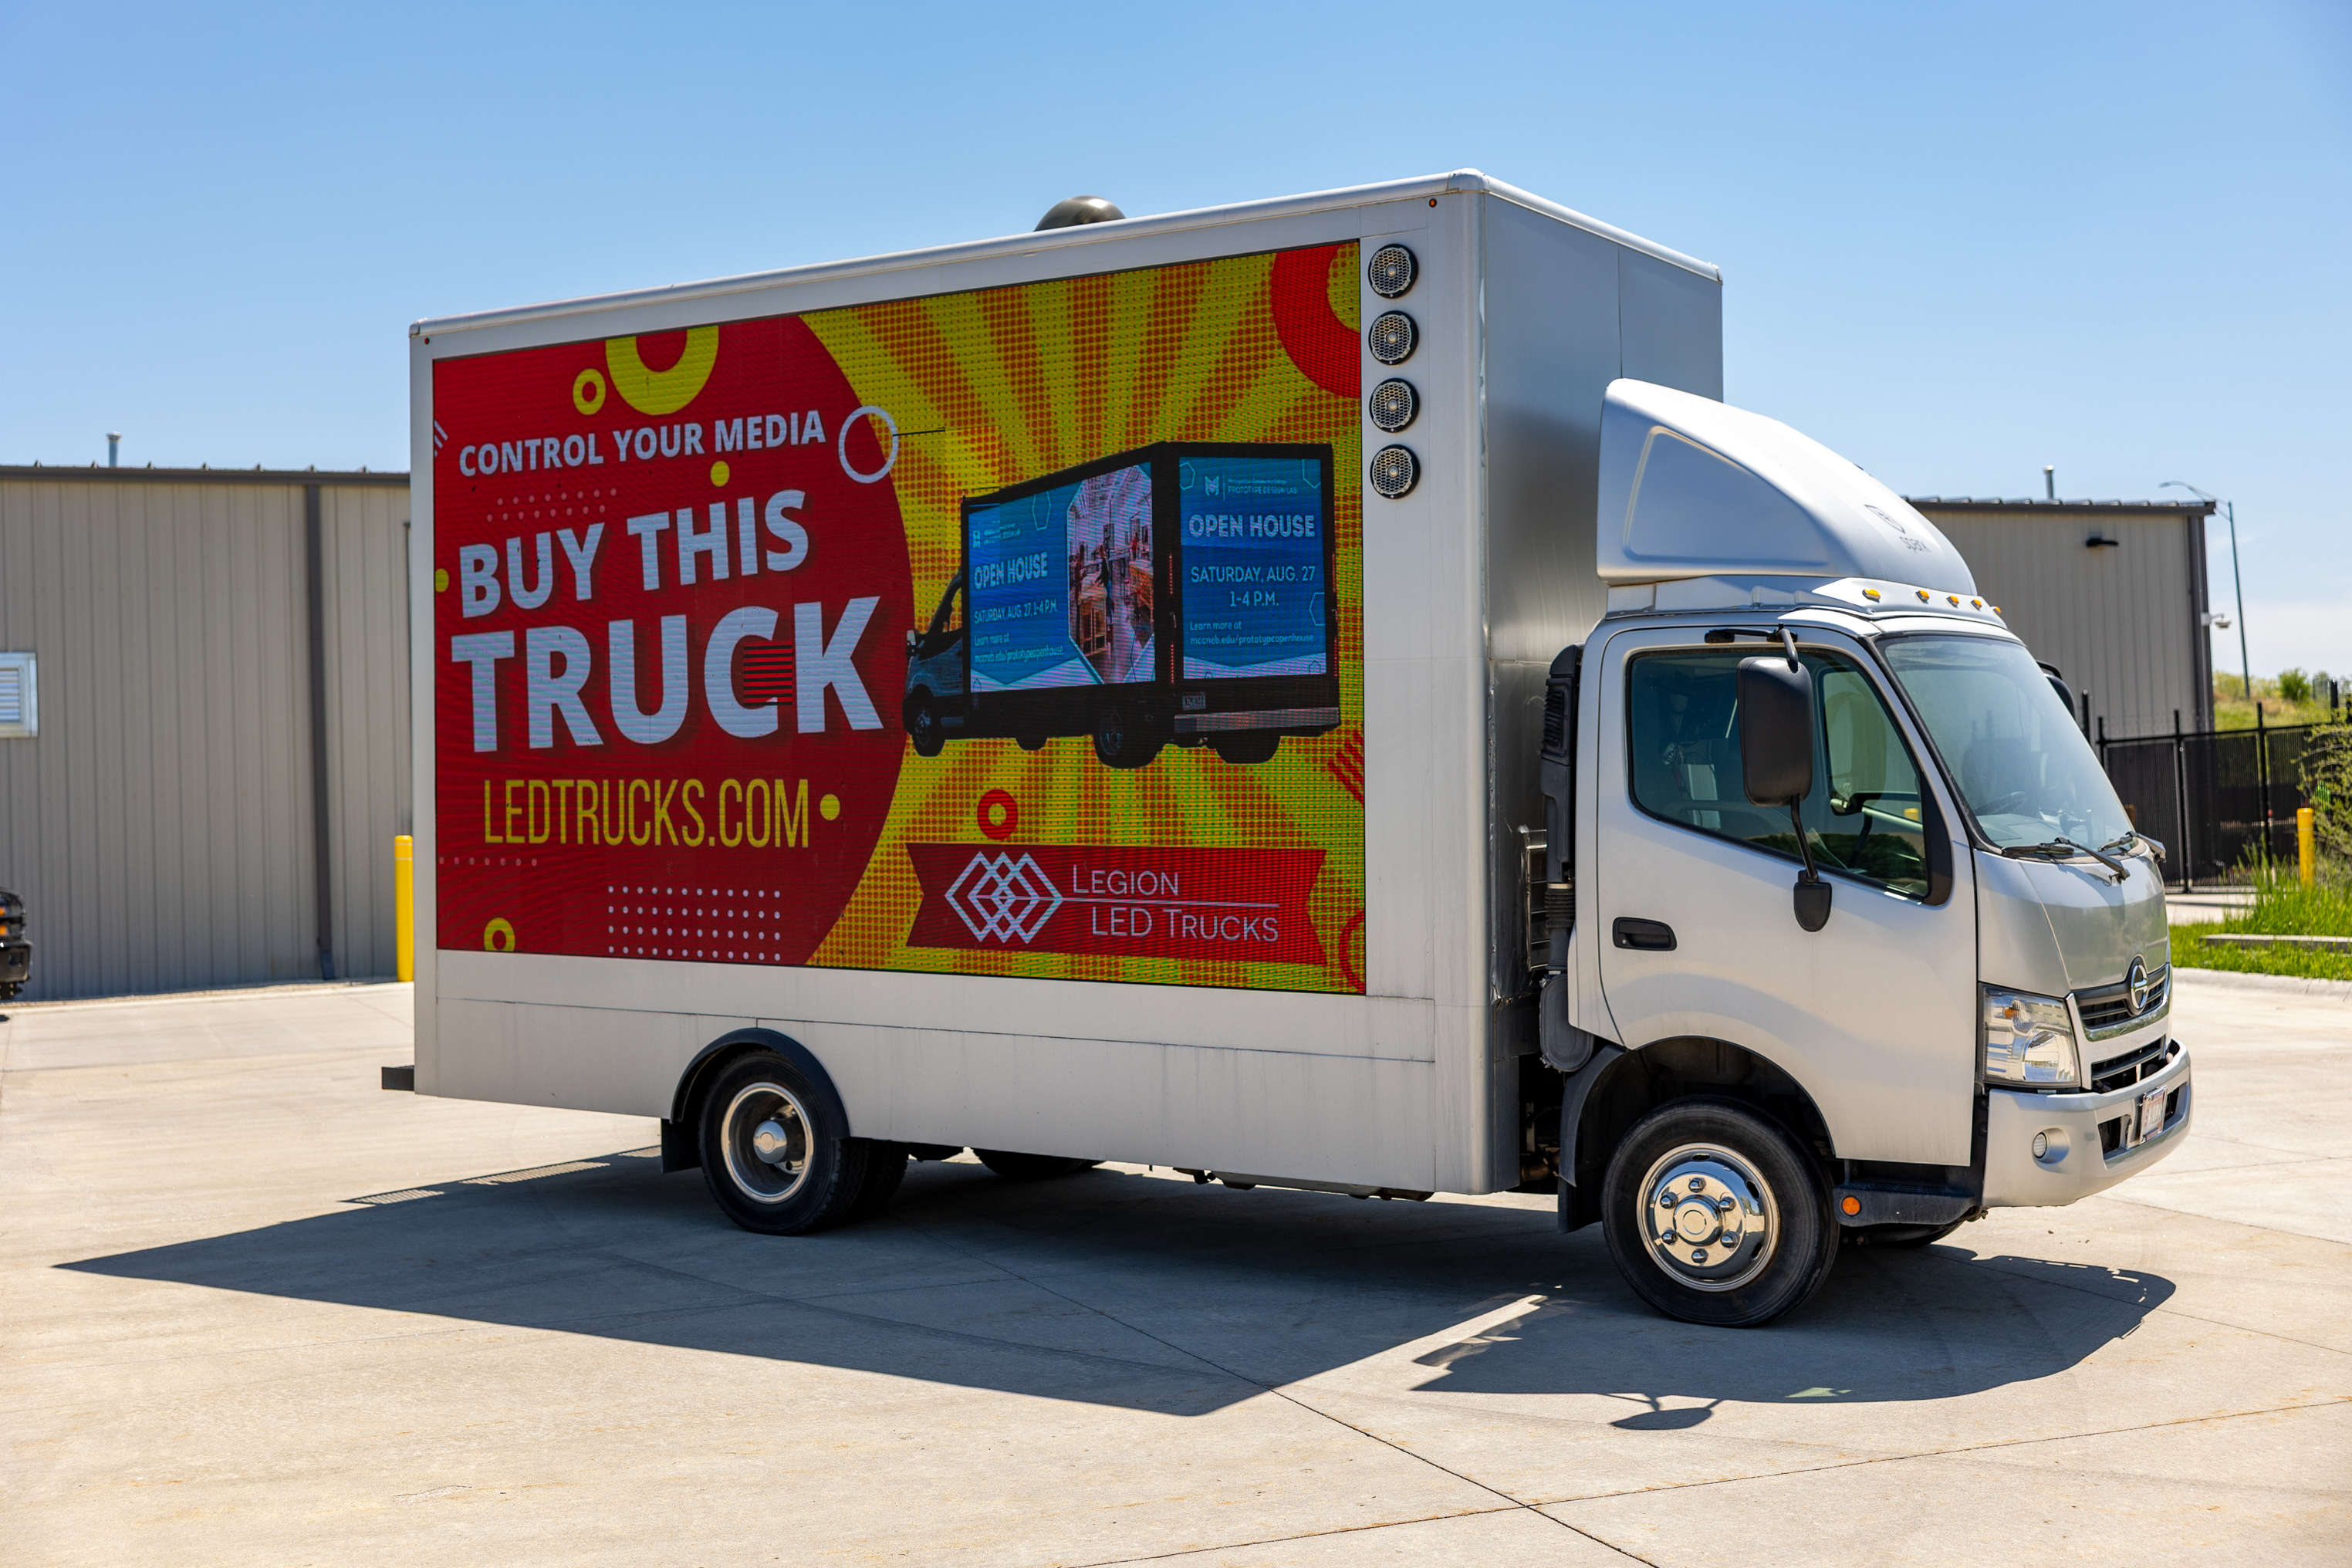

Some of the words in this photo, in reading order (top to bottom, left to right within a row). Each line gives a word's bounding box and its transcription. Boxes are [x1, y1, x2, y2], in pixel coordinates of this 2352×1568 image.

[459, 433, 604, 477] CONTROL
[613, 423, 705, 462] YOUR
[715, 410, 826, 453] MEDIA
[1189, 515, 1243, 537] OPEN
[1249, 515, 1315, 537] HOUSE
[459, 522, 605, 618] BUY
[627, 489, 809, 591] THIS
[974, 561, 1005, 590] OPEN
[1007, 552, 1048, 583] HOUSE
[1191, 566, 1264, 583] SATURDAY,
[1266, 566, 1299, 582] AUG.
[1302, 566, 1316, 581] 27
[974, 607, 1007, 624] SATURDAY,
[1008, 604, 1023, 619] AUG.
[1045, 599, 1058, 613] P.M.
[1230, 591, 1250, 607] 1-4
[1253, 591, 1279, 607] P.M.
[1189, 620, 1212, 631] Learn
[1212, 622, 1232, 630] more
[1233, 620, 1242, 630] at
[451, 596, 884, 753] TRUCK
[483, 778, 809, 848] LEDTRUCKS.COM
[1072, 864, 1180, 897] LEGION
[1092, 906, 1152, 938] LED
[1162, 908, 1279, 942] TRUCKS
